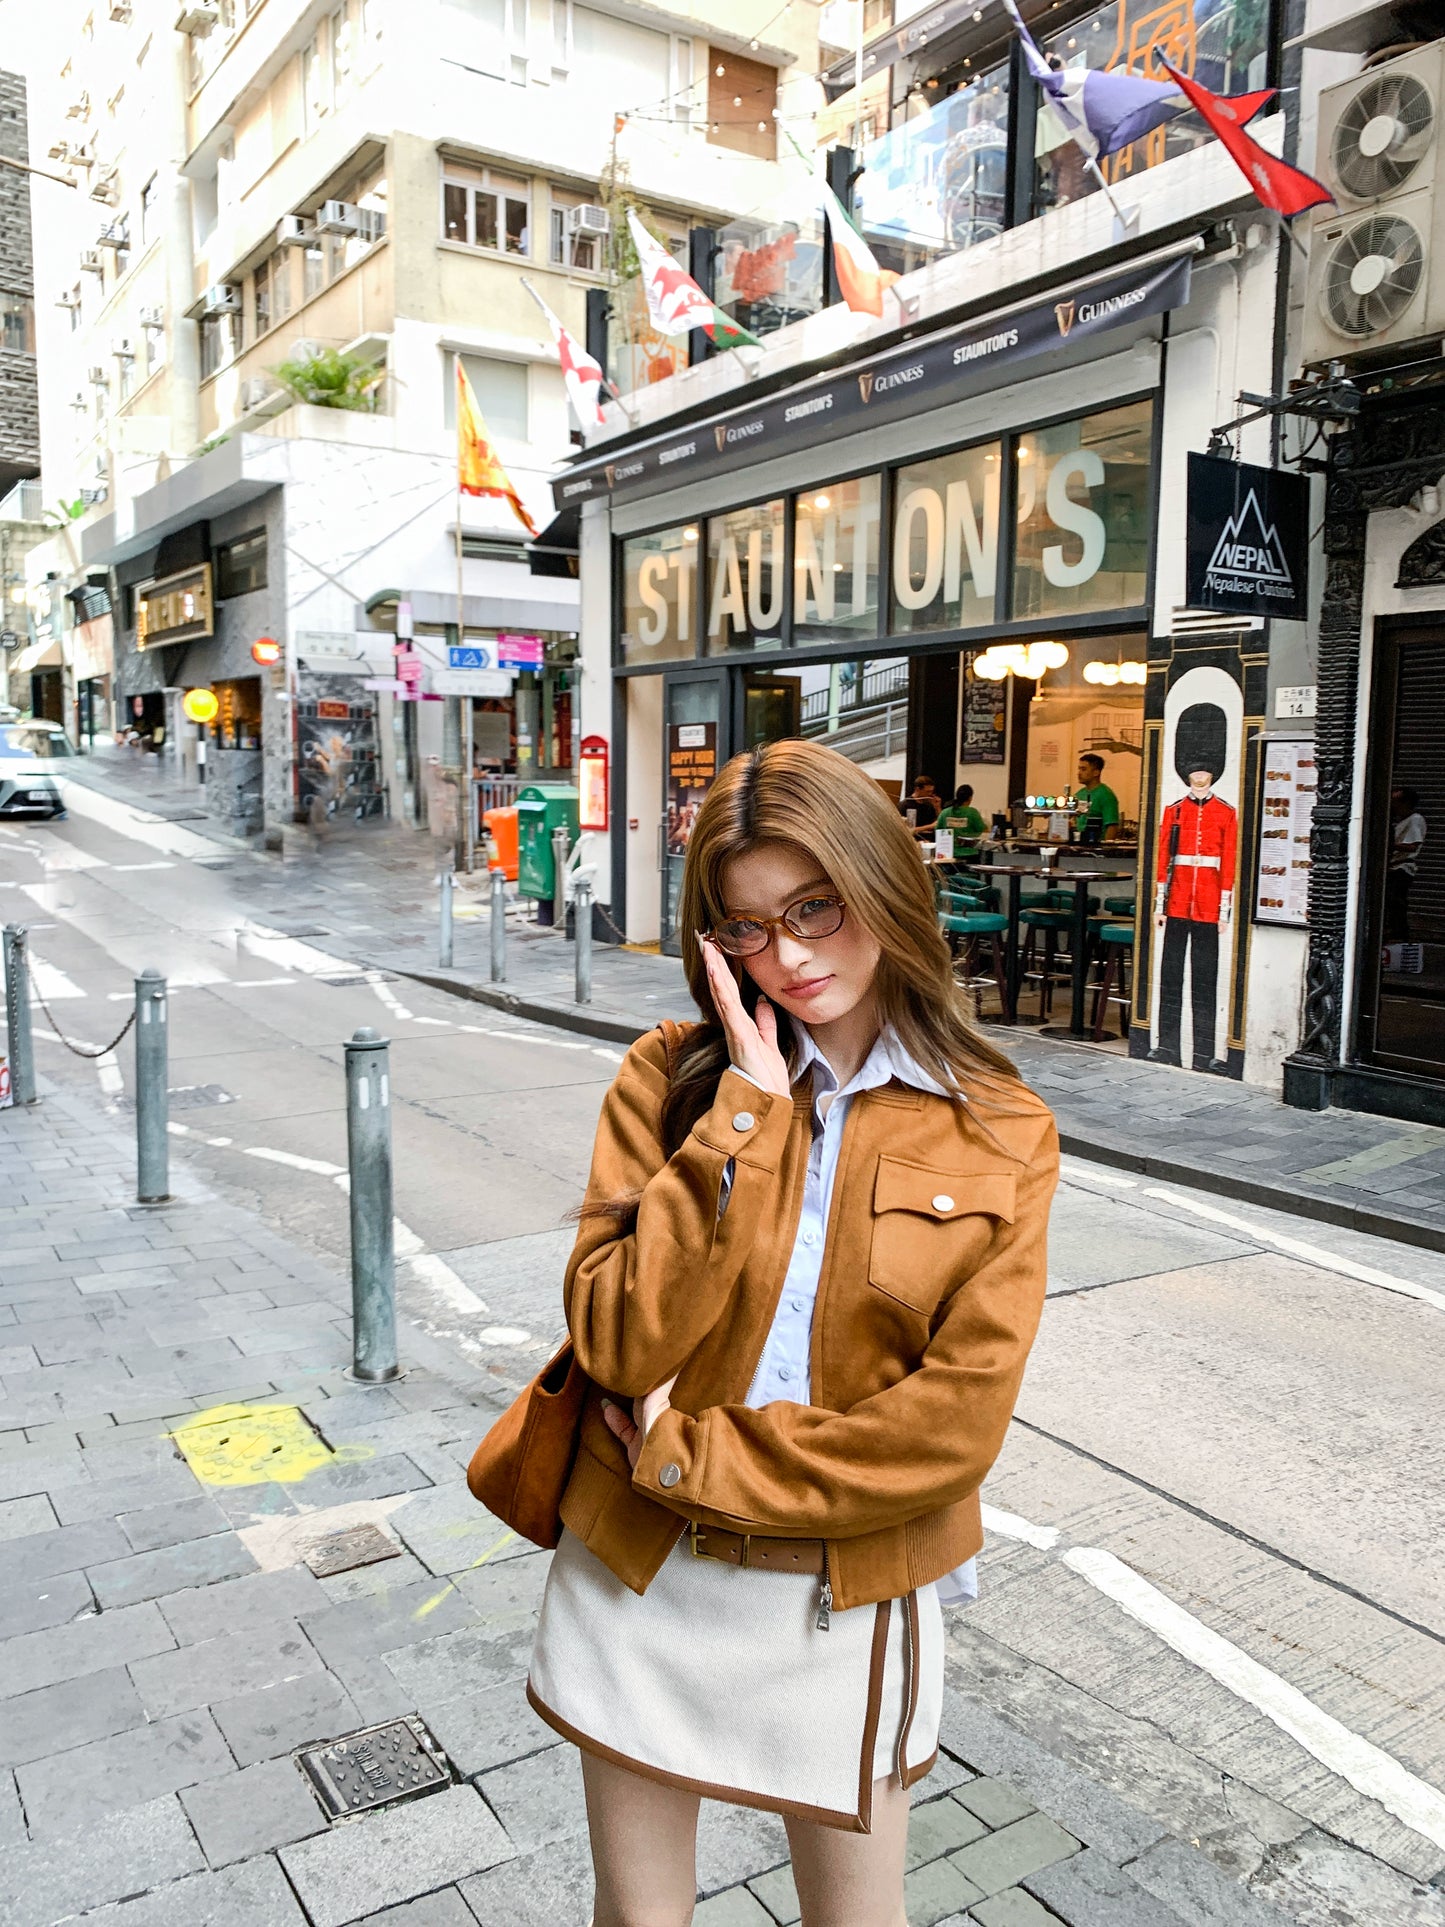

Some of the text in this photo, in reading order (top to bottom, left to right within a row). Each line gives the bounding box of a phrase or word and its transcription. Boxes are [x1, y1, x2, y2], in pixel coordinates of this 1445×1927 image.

[726, 420, 765, 443] GUINNESS
[784, 393, 834, 423] STAUNTON'S
[874, 364, 925, 394] GUINNESS
[953, 328, 1019, 366] STAUNTON'S
[1078, 286, 1147, 324] GUINNESS
[1217, 542, 1283, 574] NEPAL
[1202, 573, 1296, 599] Nepalese Cuisine
[1289, 703, 1304, 716] 14
